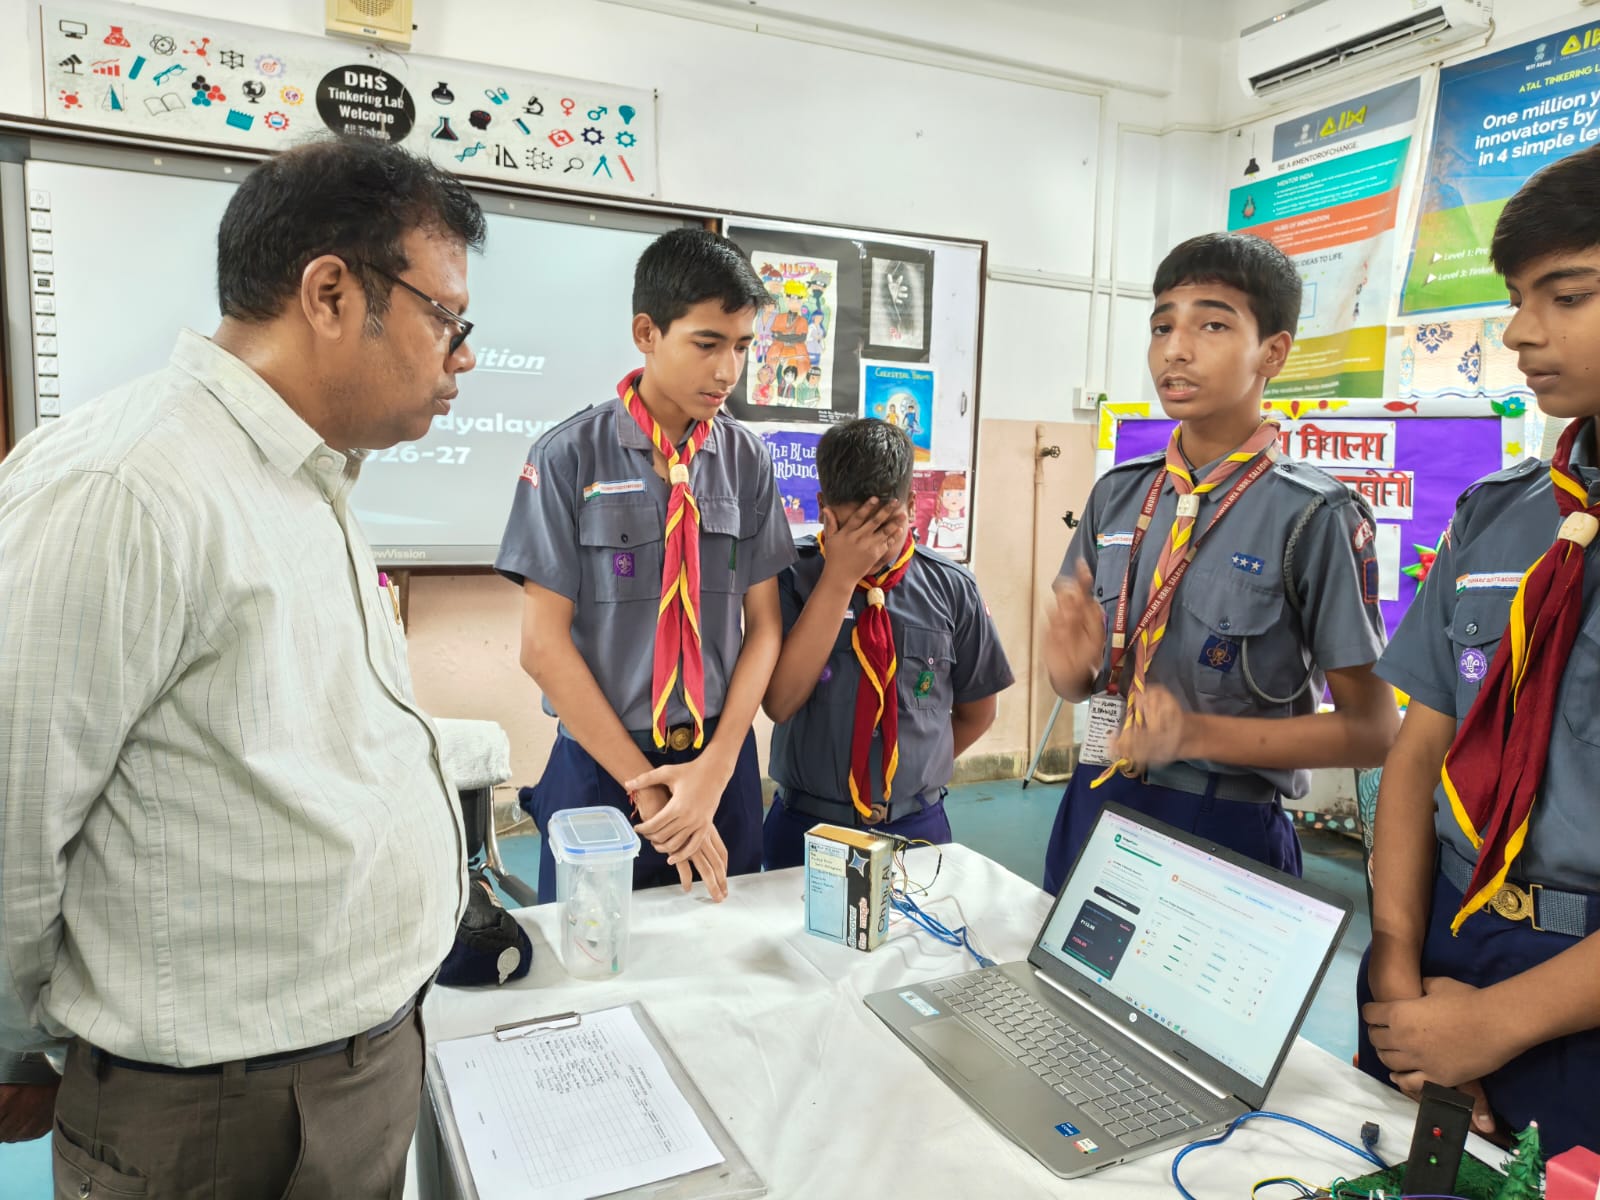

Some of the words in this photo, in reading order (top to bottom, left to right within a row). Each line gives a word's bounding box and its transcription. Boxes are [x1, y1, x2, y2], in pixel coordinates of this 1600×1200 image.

[344, 71, 388, 91] DHS
[1519, 82, 1542, 93] ATAL
[1544, 65, 1593, 86] TINKERING
[328, 87, 382, 108] Tinkering
[385, 95, 405, 109] Lab
[339, 105, 395, 124] Welcome
[1483, 112, 1518, 130] One
[1522, 93, 1586, 121] million
[1475, 117, 1569, 150] innovators
[1573, 109, 1598, 127] by
[1478, 151, 1493, 167] in
[1497, 149, 1508, 163] 4
[1511, 133, 1575, 158] simple
[477, 348, 545, 371] ition
